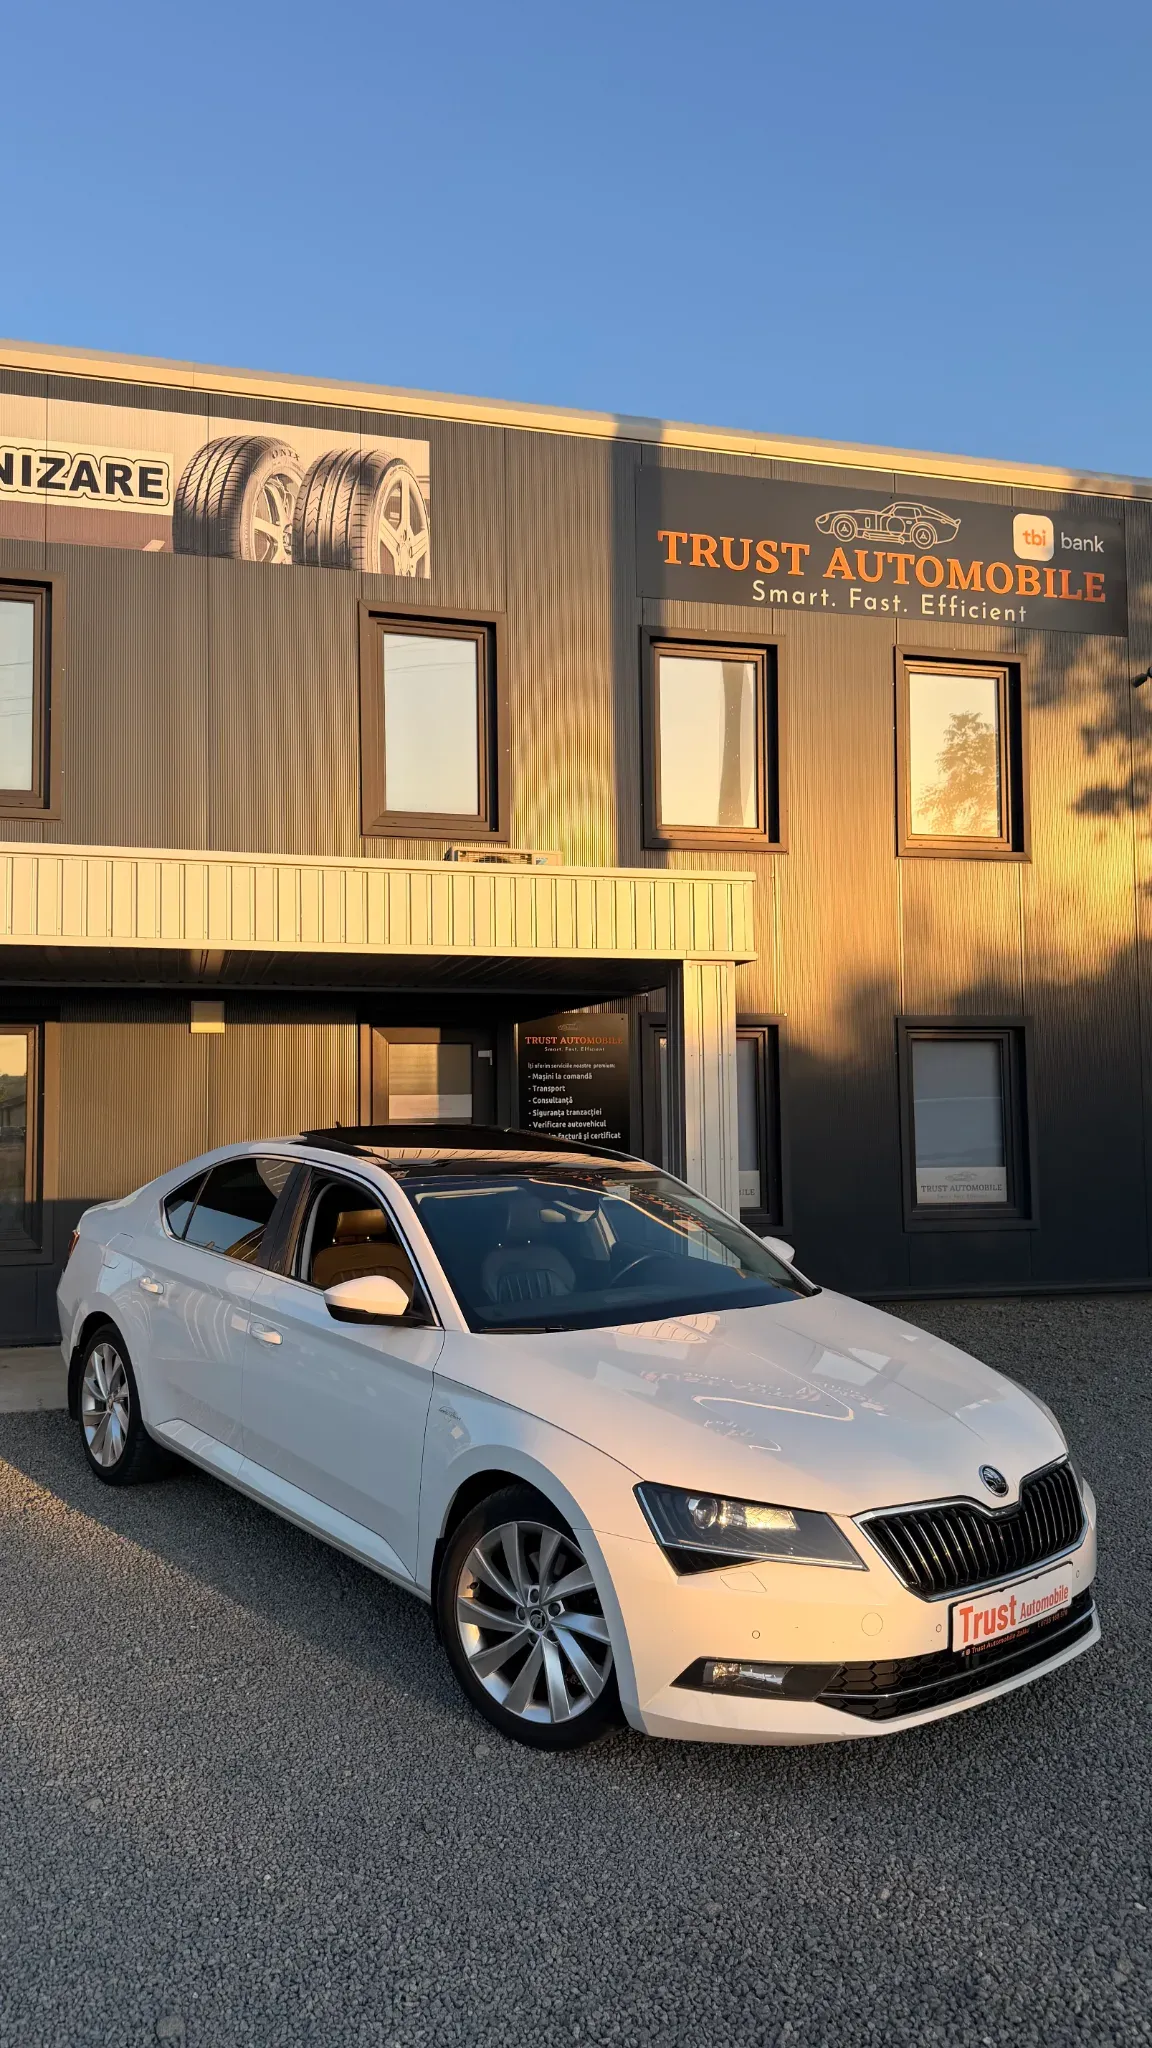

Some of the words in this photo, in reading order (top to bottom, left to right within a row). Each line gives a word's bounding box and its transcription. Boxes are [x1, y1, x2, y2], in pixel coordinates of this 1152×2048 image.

[1022, 529, 1047, 547] tbi
[1060, 532, 1104, 553] bank
[657, 530, 810, 576] TRUST
[822, 546, 1106, 603] AUTOMOBILE
[752, 580, 836, 607] Smart.
[849, 588, 908, 613] Fast.
[921, 594, 1027, 623] Efficient
[525, 1036, 558, 1044] TRUST
[560, 1036, 623, 1044] AUTOMOBILE
[959, 1595, 1017, 1643] Trust
[1020, 1585, 1068, 1620] Automobile
[972, 1644, 986, 1654] Trust
